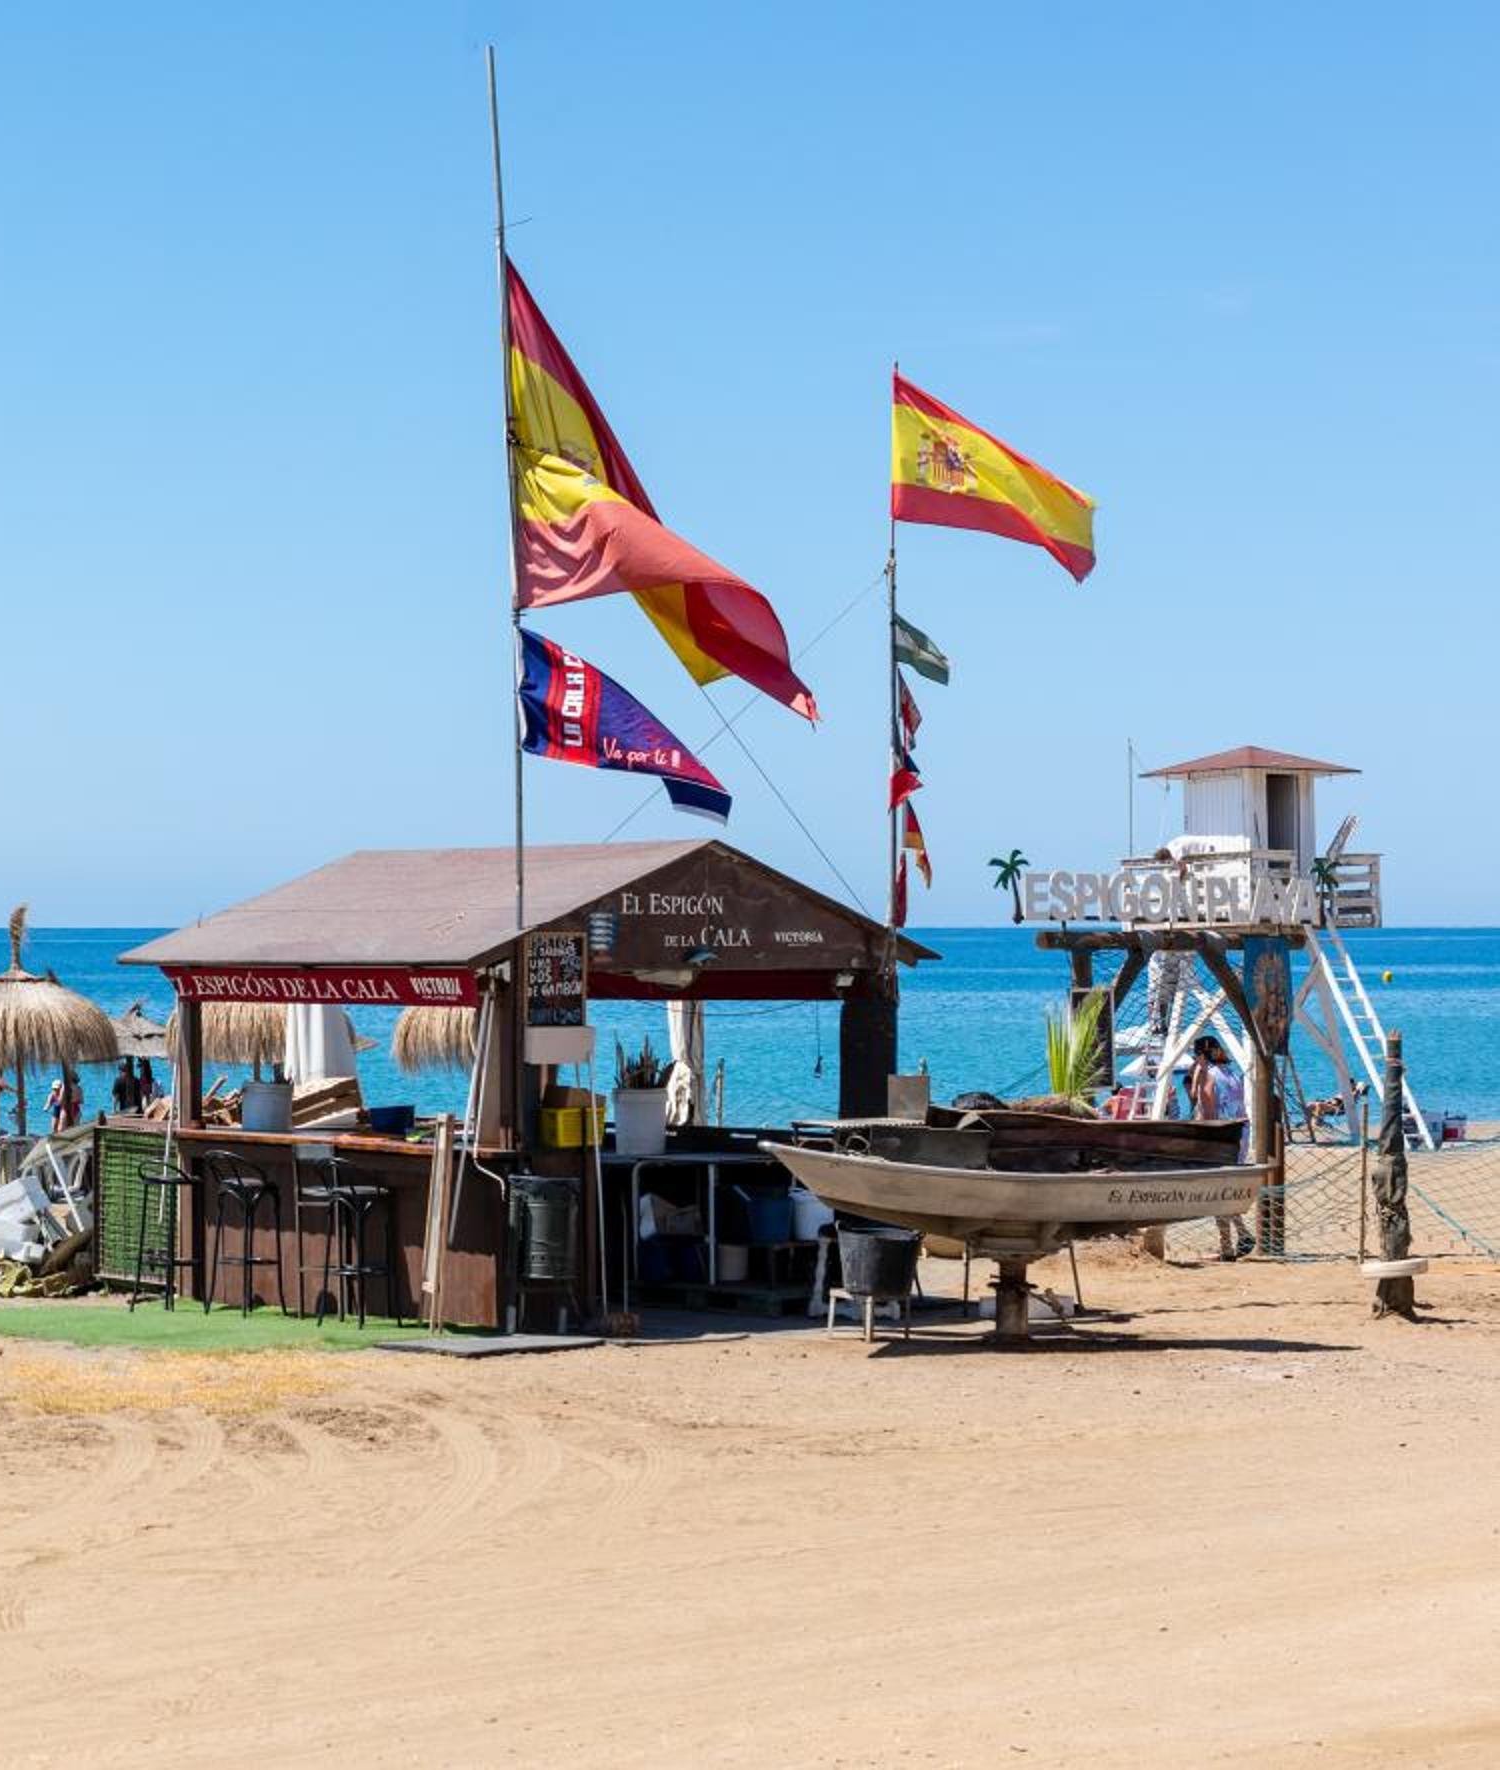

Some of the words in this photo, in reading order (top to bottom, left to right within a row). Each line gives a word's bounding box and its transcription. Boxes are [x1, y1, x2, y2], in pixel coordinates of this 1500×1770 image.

[621, 892, 644, 915] EL
[650, 892, 724, 915] ESPIGÓN
[1207, 876, 1317, 924] PLAYA
[664, 935, 680, 947] DE
[681, 935, 695, 947] LA
[773, 931, 824, 943] VICTORIA
[192, 971, 280, 998] ESPIGÓN
[280, 976, 312, 998] DE
[312, 977, 340, 999] LA
[340, 978, 399, 1000] CALA
[409, 976, 462, 995] VICTORIA
